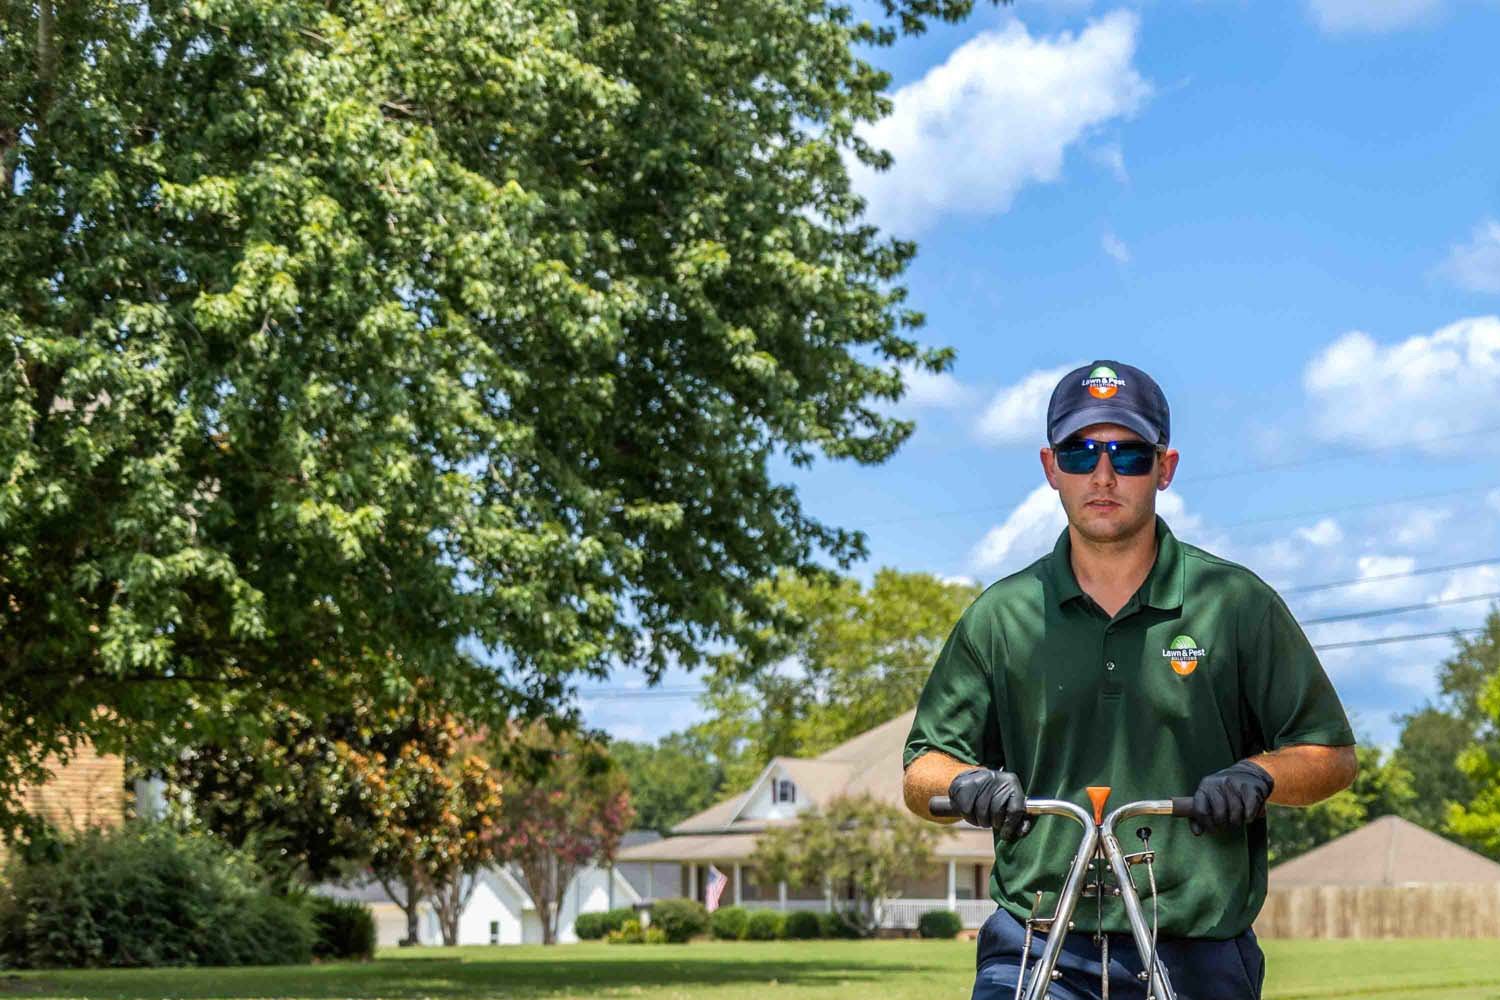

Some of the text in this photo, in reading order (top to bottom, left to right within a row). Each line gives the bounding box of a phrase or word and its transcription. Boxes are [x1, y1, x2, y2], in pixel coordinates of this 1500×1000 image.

[1162, 648, 1206, 657] Lawn & Pest
